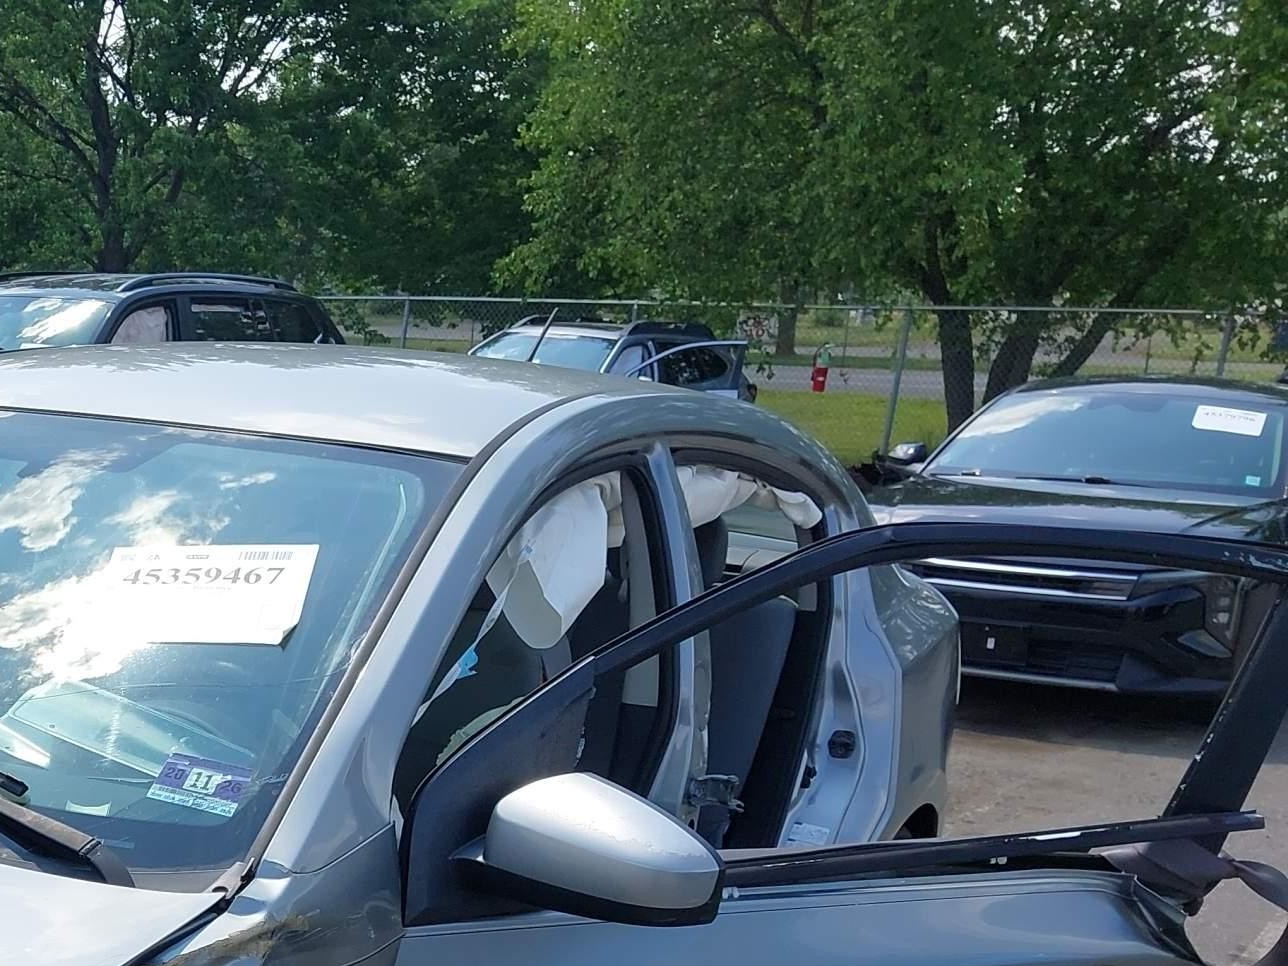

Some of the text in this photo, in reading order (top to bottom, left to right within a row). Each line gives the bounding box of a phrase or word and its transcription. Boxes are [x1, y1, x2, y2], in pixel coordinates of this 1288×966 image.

[122, 567, 286, 585] 45359467
[165, 766, 243, 794] 20 11 26
